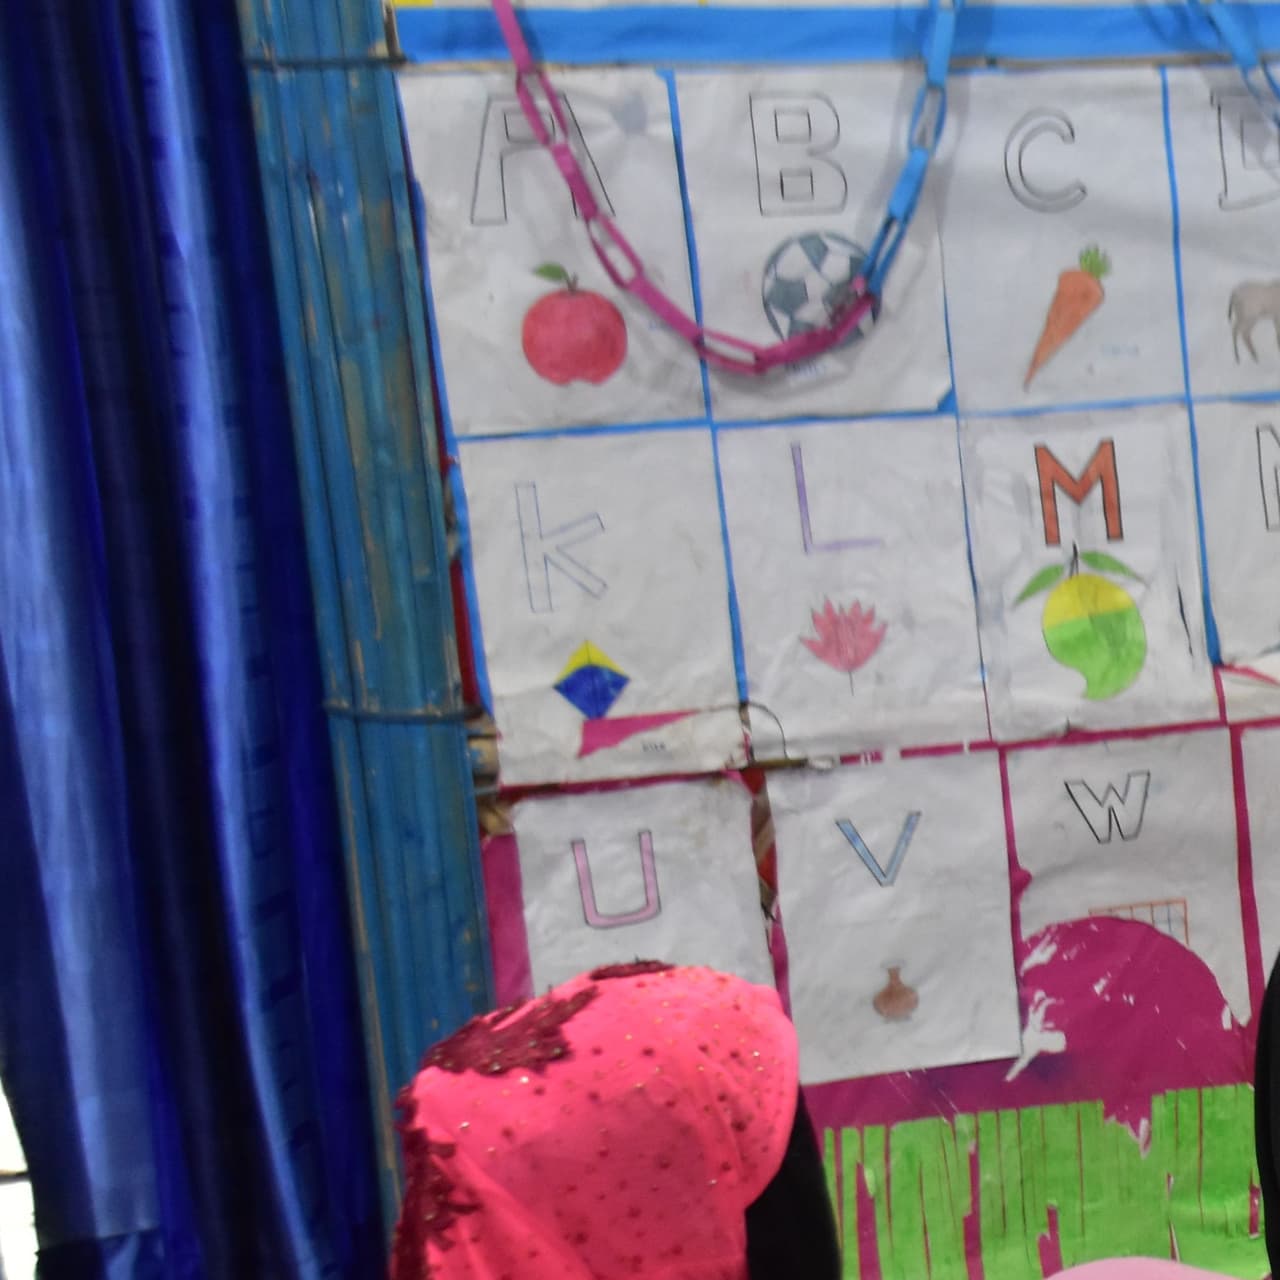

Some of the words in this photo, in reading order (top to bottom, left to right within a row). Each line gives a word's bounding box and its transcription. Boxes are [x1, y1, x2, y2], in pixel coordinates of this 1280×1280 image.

[470, 91, 616, 226] A
[749, 91, 848, 216] B
[1004, 108, 1089, 212] C
[790, 440, 884, 555] L
[1034, 437, 1124, 546] M
[571, 829, 661, 928] U
[835, 811, 922, 887] V
[1064, 770, 1152, 845] W
